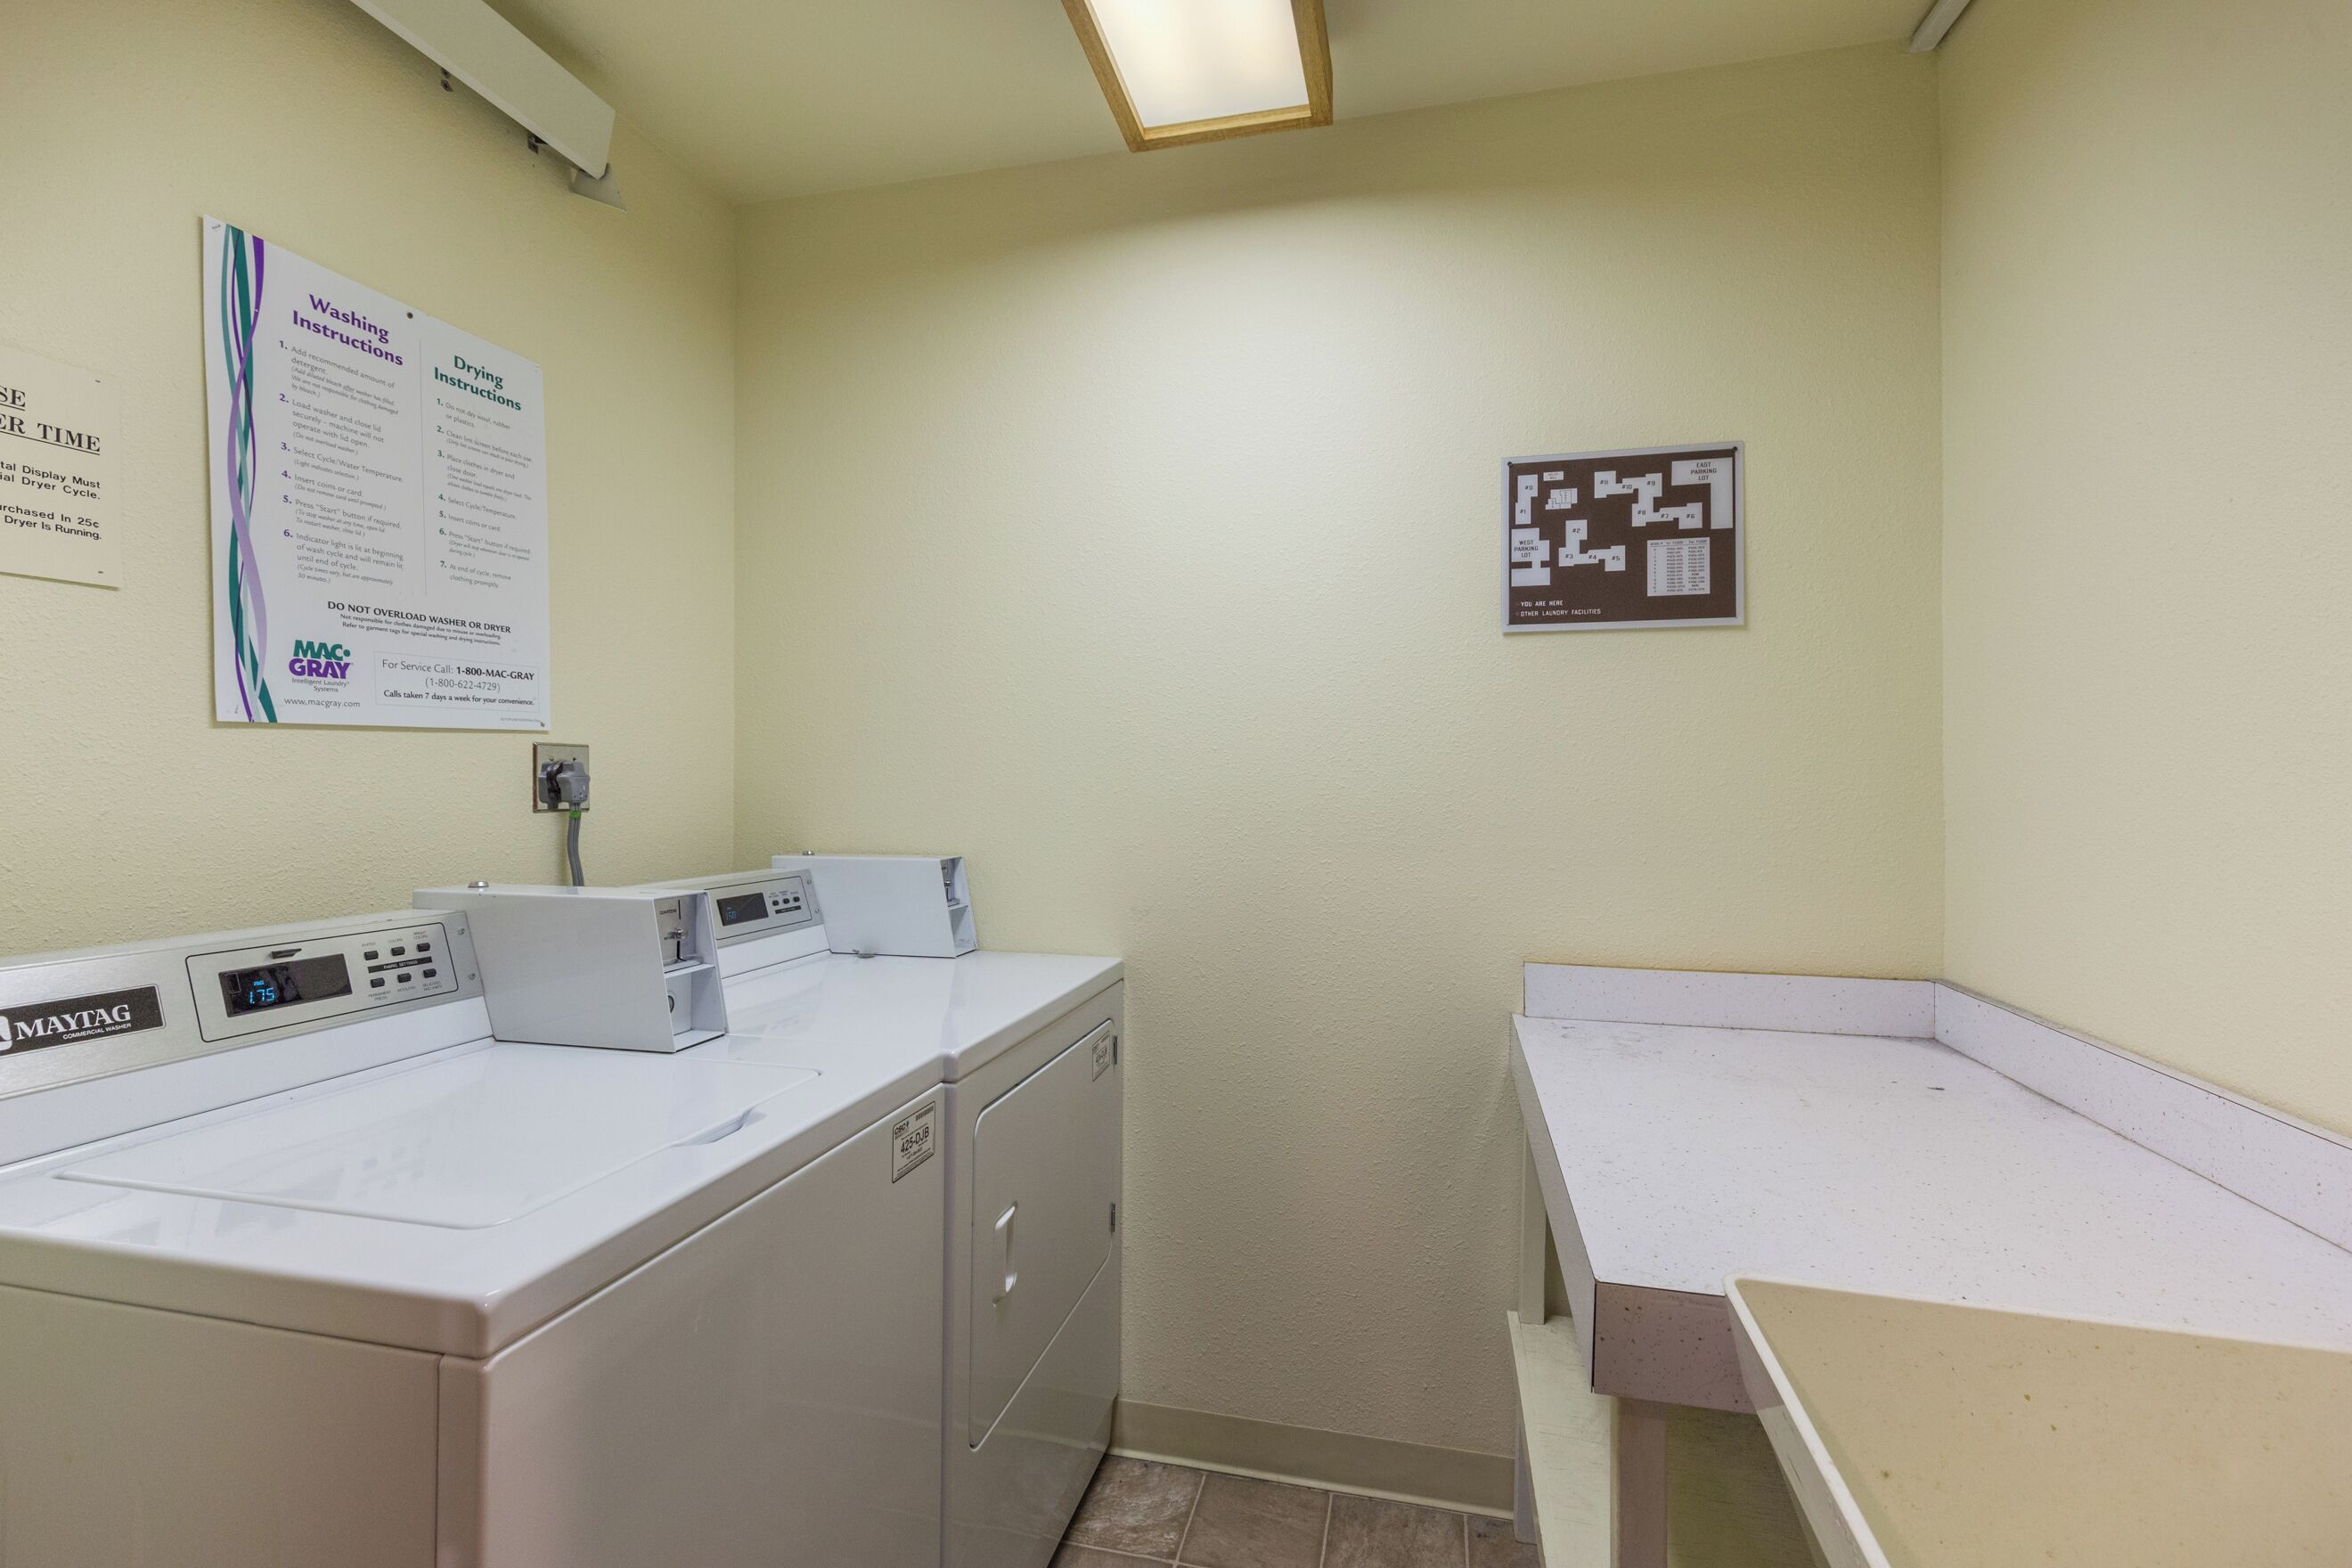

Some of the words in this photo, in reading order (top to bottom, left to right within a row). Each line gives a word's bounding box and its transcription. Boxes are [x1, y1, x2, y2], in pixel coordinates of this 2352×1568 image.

[310, 293, 389, 345] Washing
[294, 310, 403, 366] Instructions
[279, 340, 287, 350] 1.
[291, 345, 307, 358] Add
[309, 353, 358, 376] recommended
[361, 372, 386, 386] amount
[292, 356, 328, 375] detergent.
[454, 355, 503, 391] Drying
[435, 366, 521, 412] Instructions
[280, 393, 289, 403] 2.
[292, 399, 310, 411] Load
[313, 407, 337, 419] washer
[339, 415, 352, 424] and
[354, 419, 371, 429] close
[437, 398, 443, 406] 1.
[446, 402, 454, 410] Do
[467, 409, 476, 420] dry
[493, 421, 510, 430] rubber
[293, 411, 321, 426] securely
[329, 422, 358, 435] machine
[293, 422, 321, 434] operate
[323, 430, 338, 439] with
[340, 434, 348, 442] lid
[37, 423, 100, 452] TIME
[437, 425, 444, 434] 2.
[474, 440, 490, 449] screen
[493, 445, 508, 455] before
[281, 442, 290, 452] 3.
[294, 447, 314, 459] Select
[317, 453, 359, 471] Cycle/Water
[437, 449, 444, 458] 3.
[22, 465, 66, 483] Display
[72, 476, 101, 489] Must
[282, 469, 291, 479] 4.
[295, 474, 315, 485] Insert
[317, 482, 335, 490] coins
[447, 465, 461, 474] close
[21, 477, 56, 490] Dryer
[62, 485, 101, 499] Cycle.
[283, 495, 292, 504] 5.
[296, 499, 314, 509] Press
[343, 510, 365, 521] button
[448, 497, 464, 506] Select
[4, 515, 37, 527] Dryer
[41, 521, 52, 531] Is
[55, 524, 102, 540] Running.
[61, 514, 71, 523] In
[439, 510, 446, 519] 5.
[449, 514, 464, 523] Insert
[439, 528, 446, 536] 6.
[284, 529, 293, 538] 6.
[297, 533, 329, 546] Indicator
[332, 540, 346, 550] light
[372, 548, 403, 562] beginning
[440, 560, 447, 568] 7.
[328, 601, 345, 612] DO
[348, 604, 371, 615] NOT
[374, 608, 426, 622] OVERLOAD
[430, 615, 466, 627] WASHER
[469, 621, 481, 629] OR
[484, 623, 511, 633] DRYER
[289, 658, 351, 679] GRAY
[383, 659, 398, 669] For
[401, 661, 431, 672] Service
[434, 664, 453, 674] Call:
[456, 666, 535, 680] 1-800-MAC-GRAY
[384, 690, 401, 698] Calls
[404, 691, 423, 699] taken
[432, 693, 446, 702] days
[425, 677, 500, 693] (1-800-622-4729)
[285, 699, 360, 709] www.macgray.com
[14, 1004, 131, 1041] MAYTAG
[63, 1028, 105, 1040] COMMERCIAL
[106, 1023, 131, 1032] WASHER
[894, 1123, 906, 1135] CSC
[900, 1126, 929, 1153] 425-DJB
